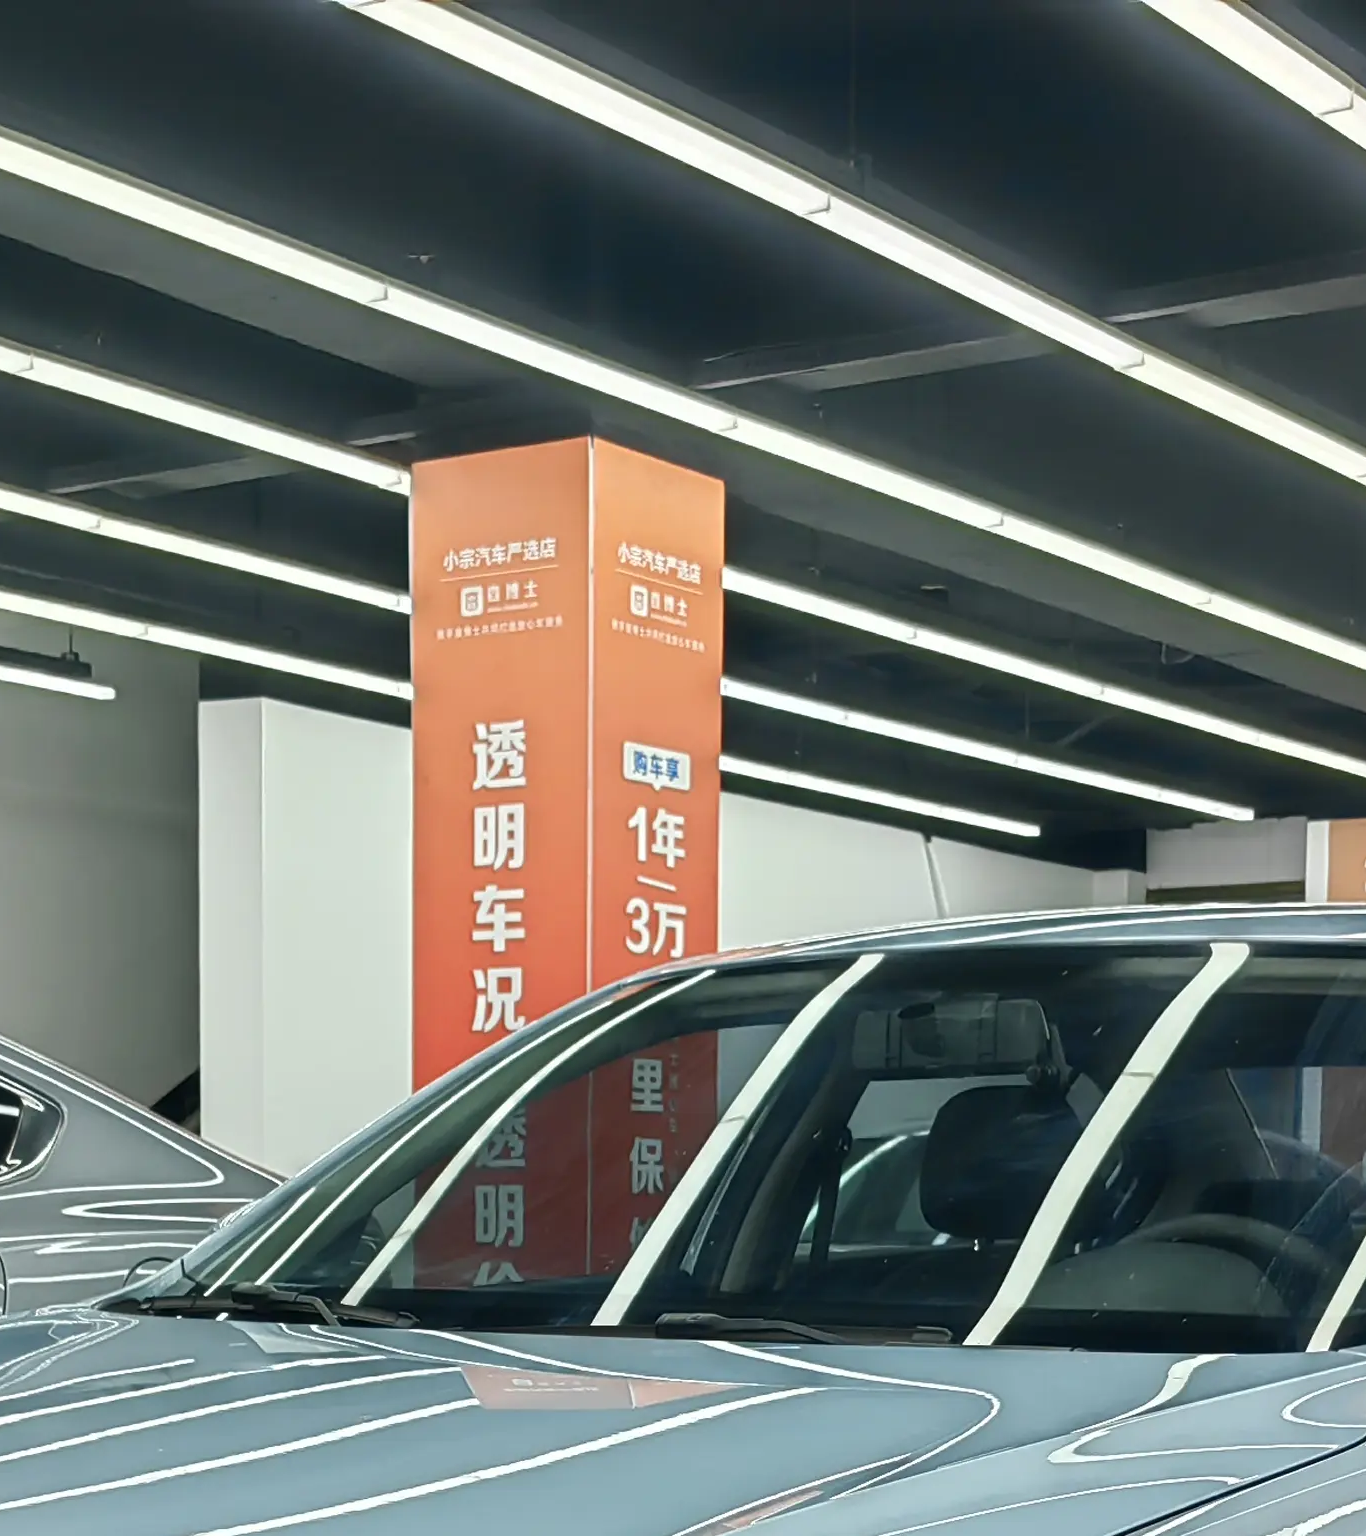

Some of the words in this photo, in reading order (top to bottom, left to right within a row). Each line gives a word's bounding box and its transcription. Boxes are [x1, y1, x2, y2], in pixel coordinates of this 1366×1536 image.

[443, 537, 556, 572] 小宗汽车严选店
[617, 541, 701, 584] 小宗汽车严选店
[632, 750, 680, 783] 购车享
[627, 805, 686, 868] 1年
[471, 719, 527, 1033] 透明车况
[625, 896, 687, 959] 3万
